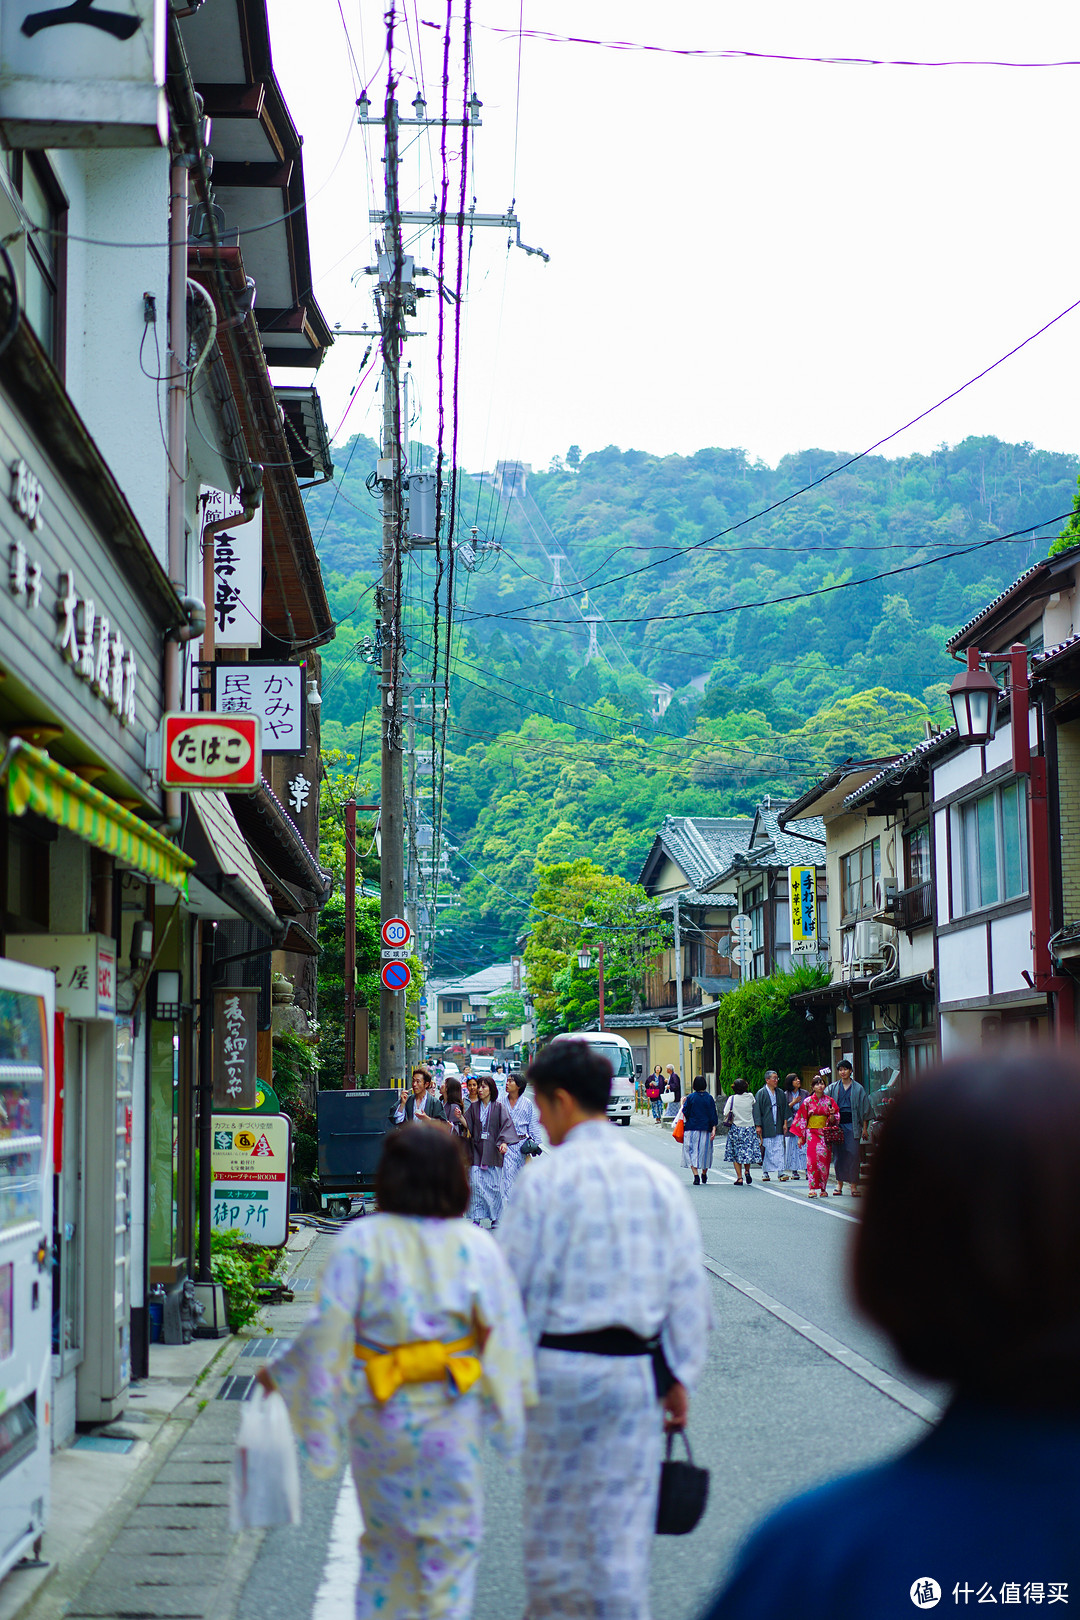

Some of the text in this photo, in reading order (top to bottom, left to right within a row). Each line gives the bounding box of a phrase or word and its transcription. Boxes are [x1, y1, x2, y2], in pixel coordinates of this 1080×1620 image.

[221, 674, 252, 713] 民藝
[264, 674, 294, 740] かみや
[178, 734, 242, 765] たばこ
[288, 773, 312, 814] 楽
[791, 880, 802, 926] 中華そば
[802, 874, 817, 932] 手打そば
[388, 926, 405, 940] 30
[383, 950, 409, 958] 区域内
[214, 1173, 277, 1181] FE・ハーブティーROOM
[213, 1202, 269, 1229] 御所
